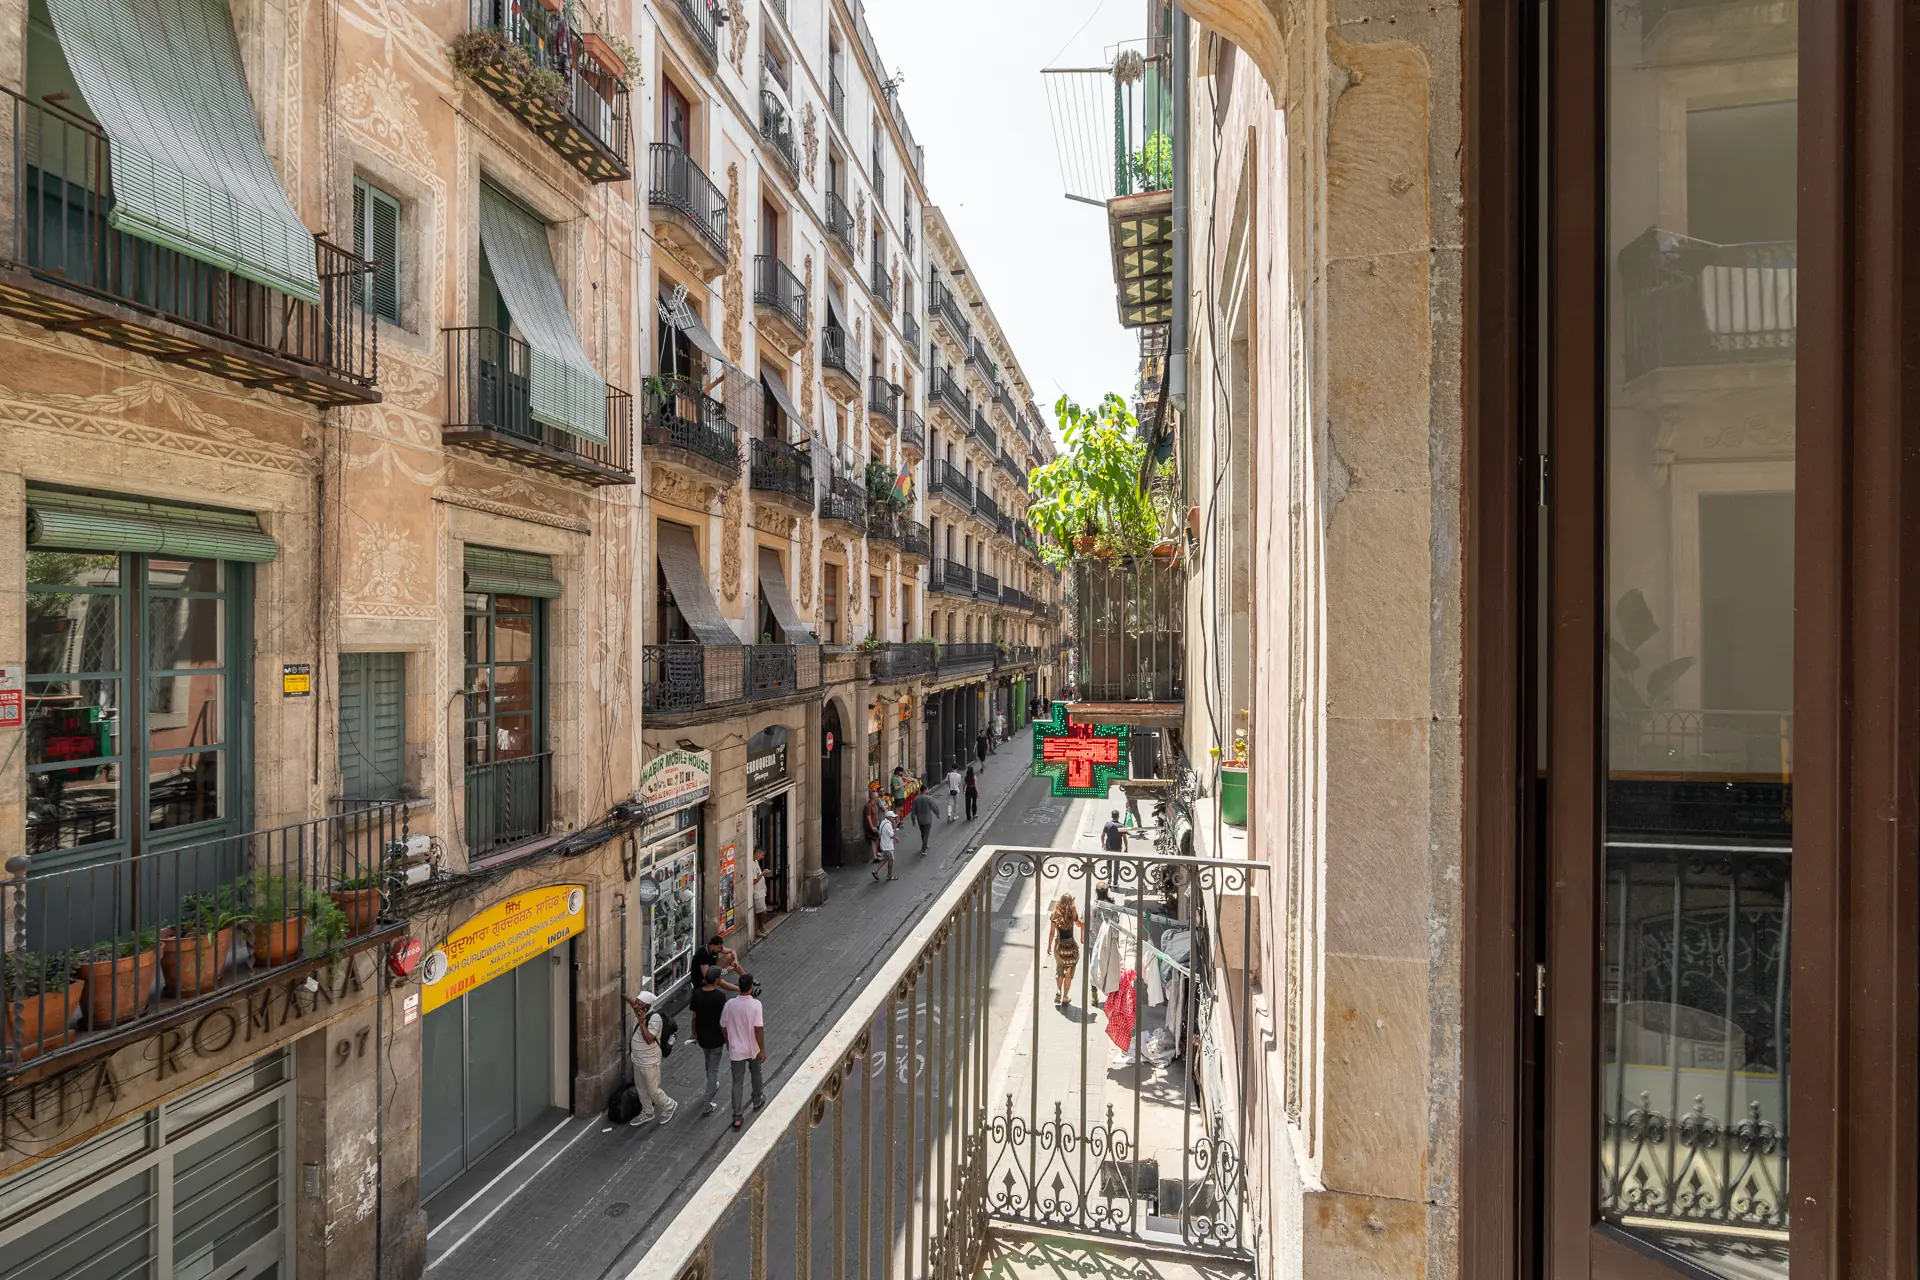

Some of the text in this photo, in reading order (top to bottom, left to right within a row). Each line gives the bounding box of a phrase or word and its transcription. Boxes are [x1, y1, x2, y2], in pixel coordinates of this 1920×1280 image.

[688, 753, 709, 774] HOUSE
[461, 940, 506, 968] GURUDWARA
[508, 919, 549, 946] GURDARSHAN
[547, 926, 570, 945] INDIA
[445, 973, 476, 999] INDIA
[156, 955, 366, 1081] ROMANA
[335, 1026, 371, 1068] 97
